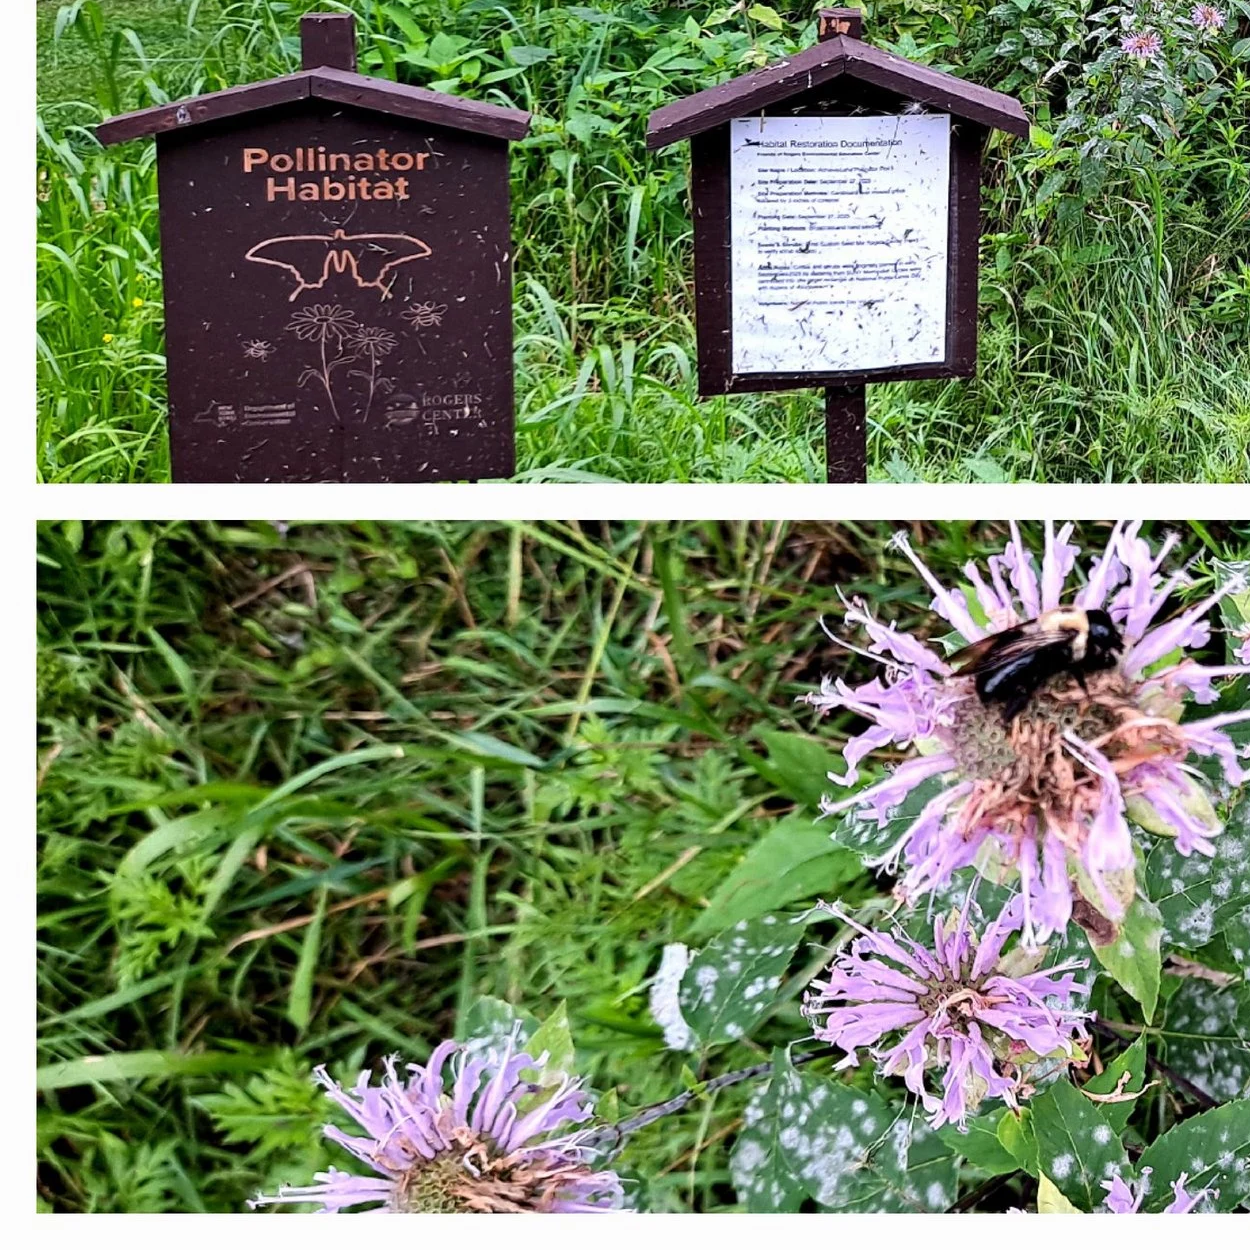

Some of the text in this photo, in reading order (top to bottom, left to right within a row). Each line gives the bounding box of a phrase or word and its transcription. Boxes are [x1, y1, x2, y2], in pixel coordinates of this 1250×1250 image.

[790, 140, 838, 148] Restoration
[840, 139, 903, 148] Documentation
[243, 146, 430, 173] Pollinator
[266, 175, 411, 202] Habitat
[422, 393, 482, 406] ROGERS
